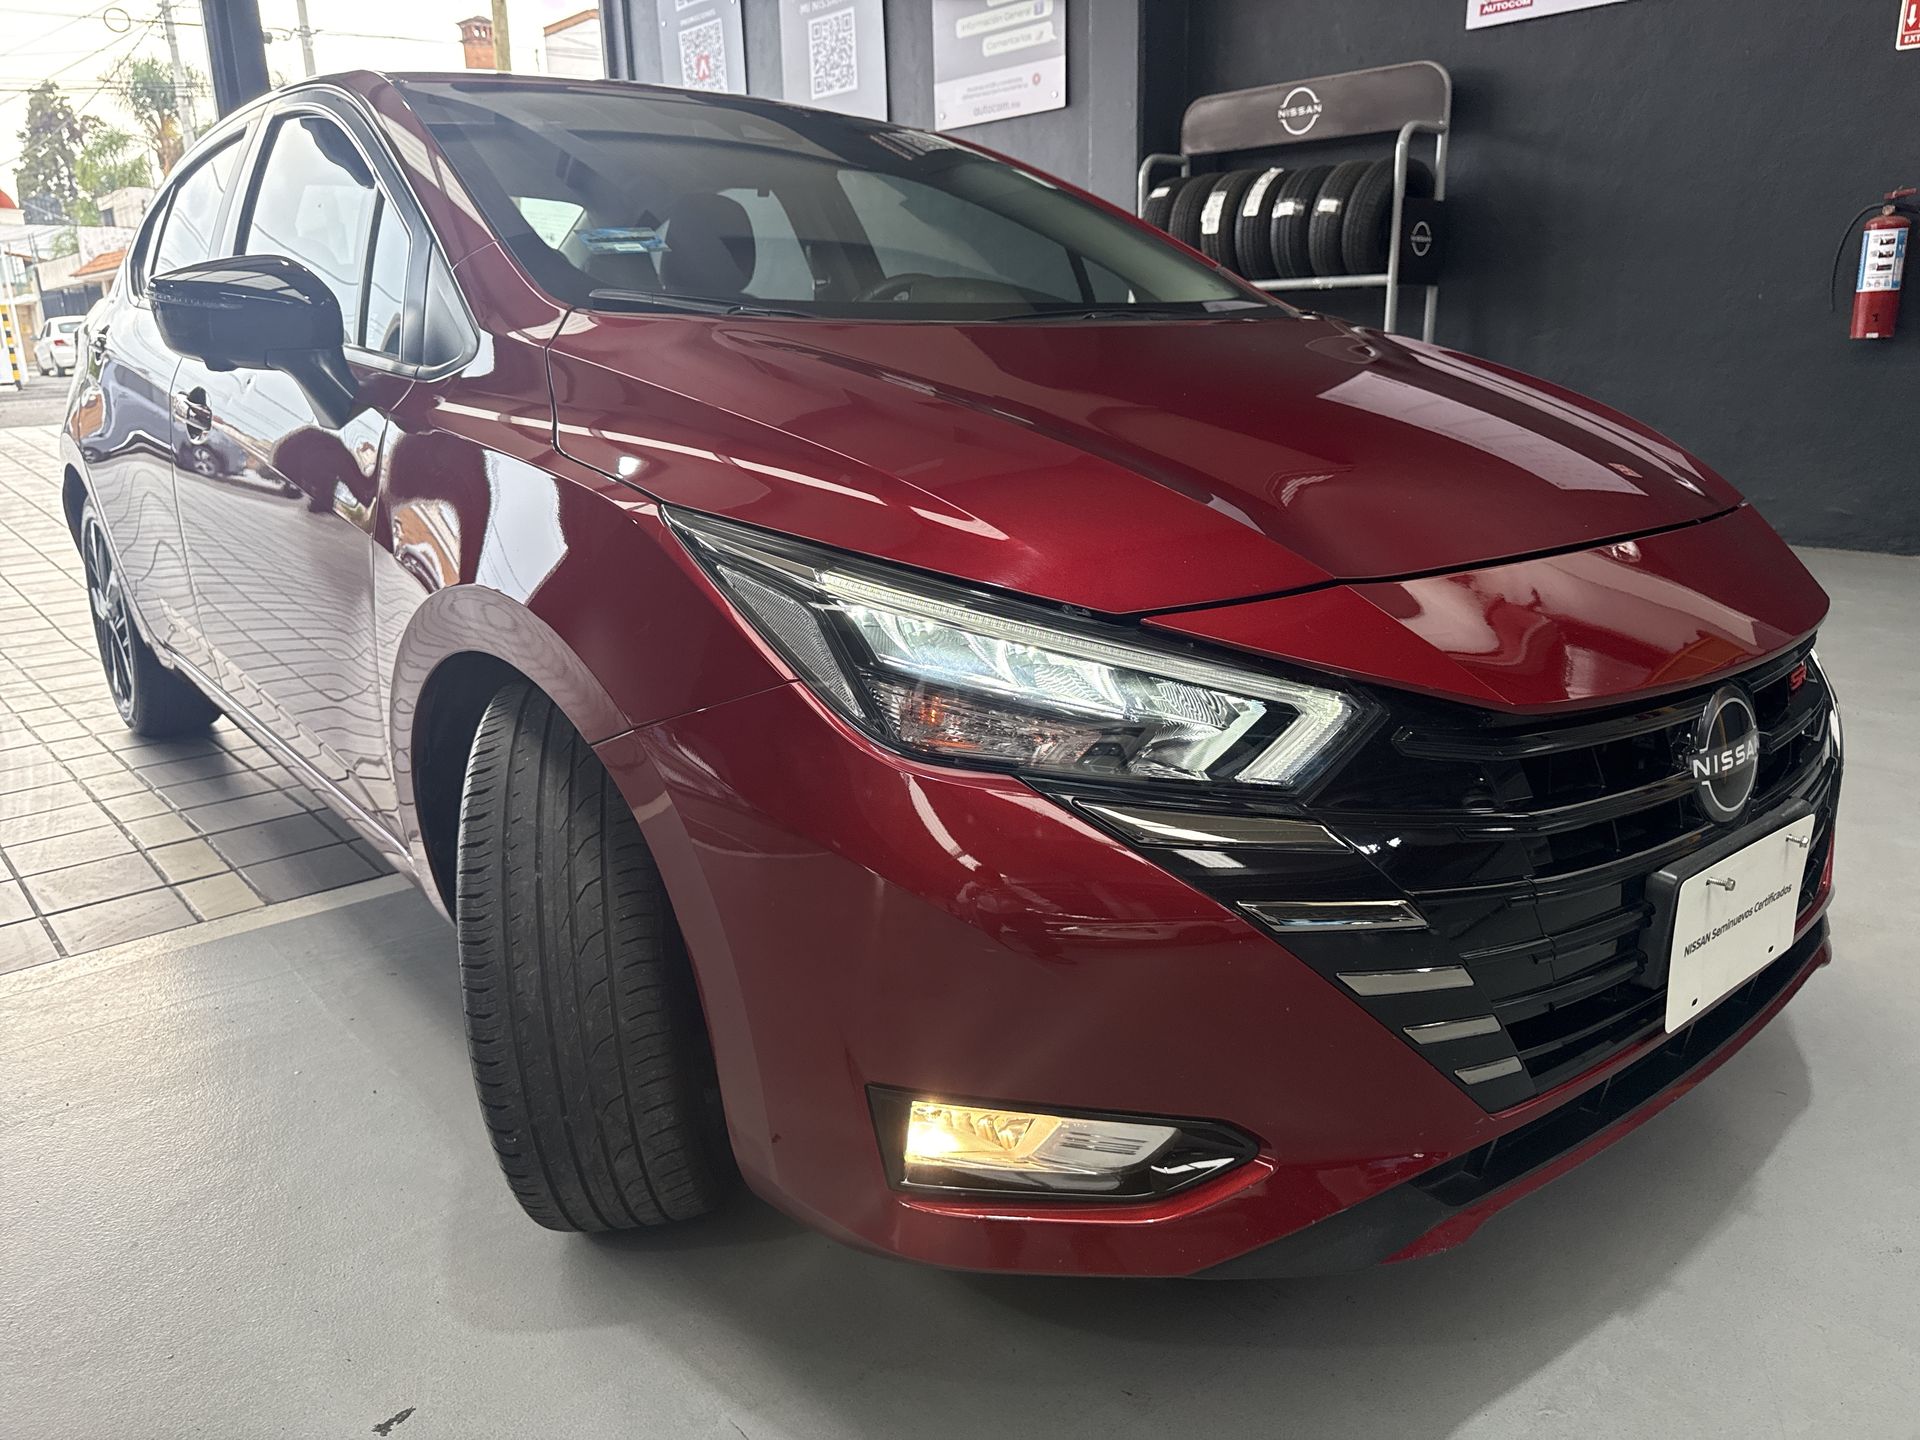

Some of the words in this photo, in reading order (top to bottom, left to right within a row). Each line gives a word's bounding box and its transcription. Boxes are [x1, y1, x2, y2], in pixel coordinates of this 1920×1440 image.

[1278, 104, 1322, 118] NISSAN
[1684, 932, 1711, 958] NISSAN
[1712, 907, 1753, 940] Seminuevos
[1754, 884, 1792, 913] Certificados
